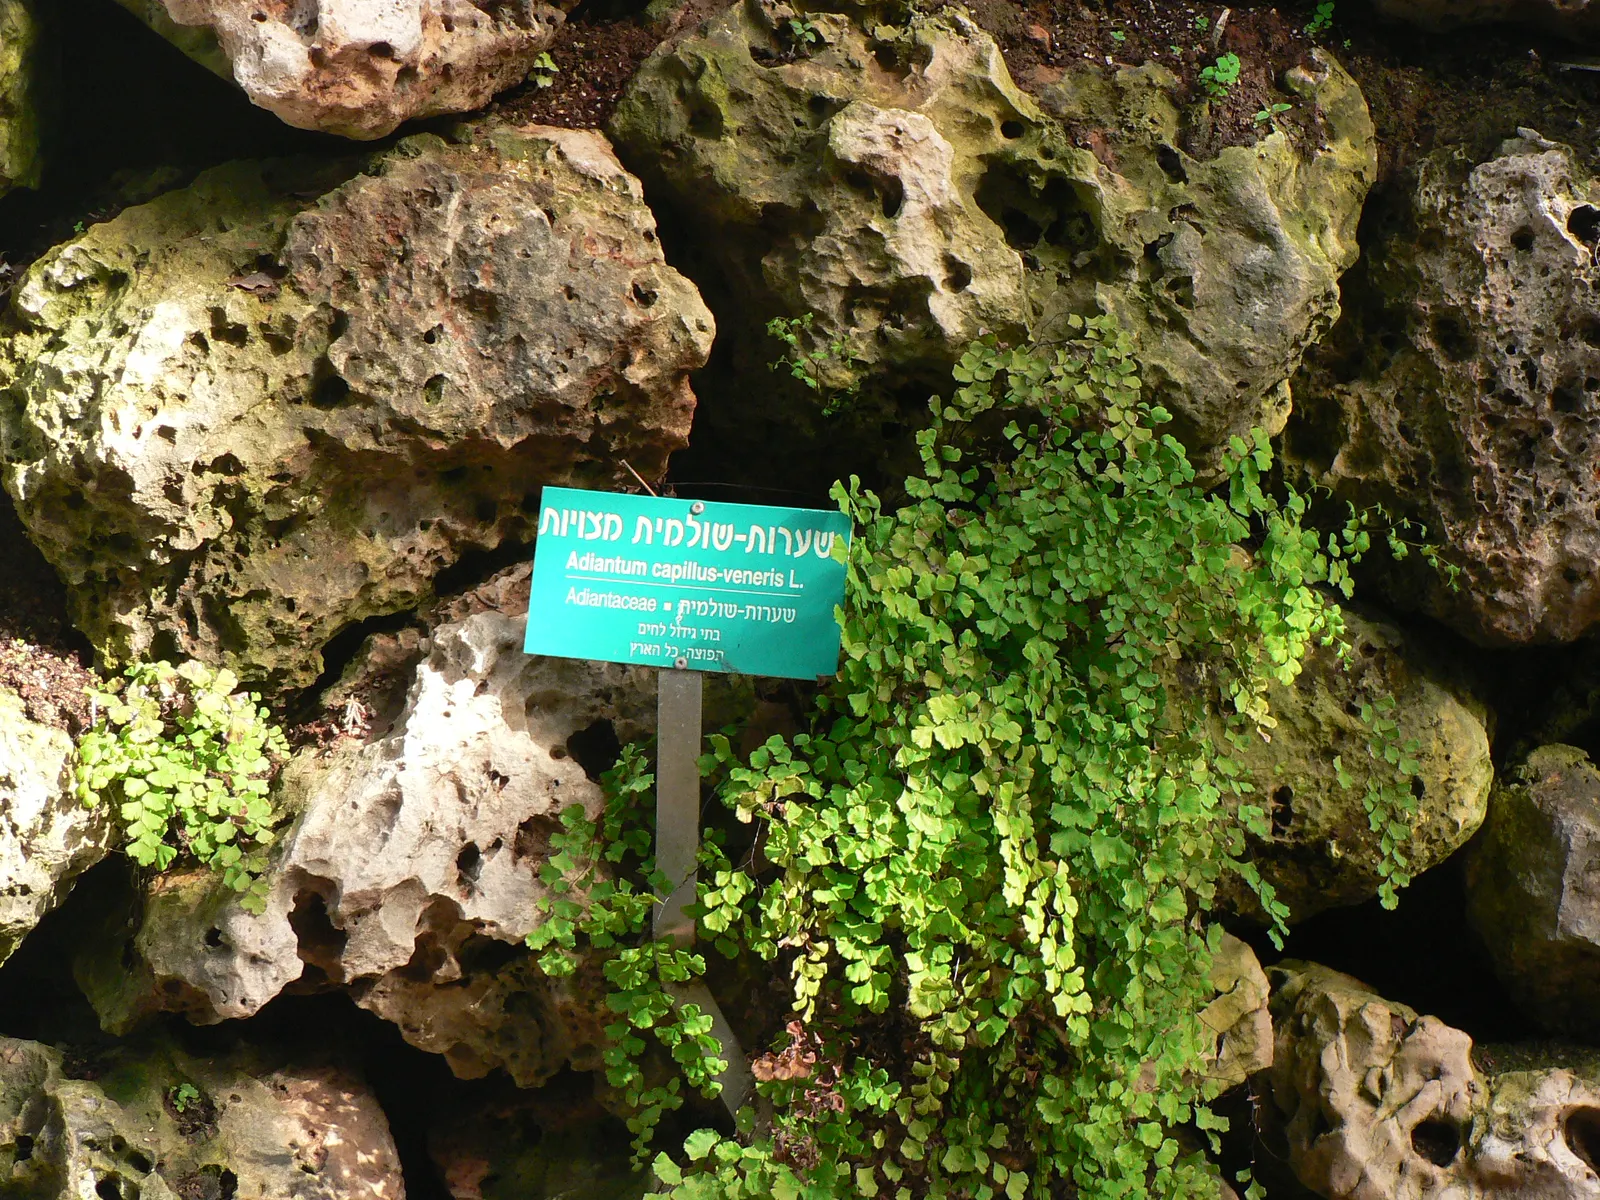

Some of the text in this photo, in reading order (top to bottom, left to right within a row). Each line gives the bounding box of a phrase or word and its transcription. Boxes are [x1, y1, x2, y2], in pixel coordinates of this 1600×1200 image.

[538, 507, 834, 559] שערות-שולמית מצויות
[565, 550, 804, 589] Adiantum capillus-veneris L.
[565, 586, 657, 612] Adiantaceae
[677, 597, 796, 623] שערות-שולמית
[638, 622, 721, 641] בתי גידול לחים
[629, 641, 661, 657] הארץ
[664, 642, 679, 658] כל
